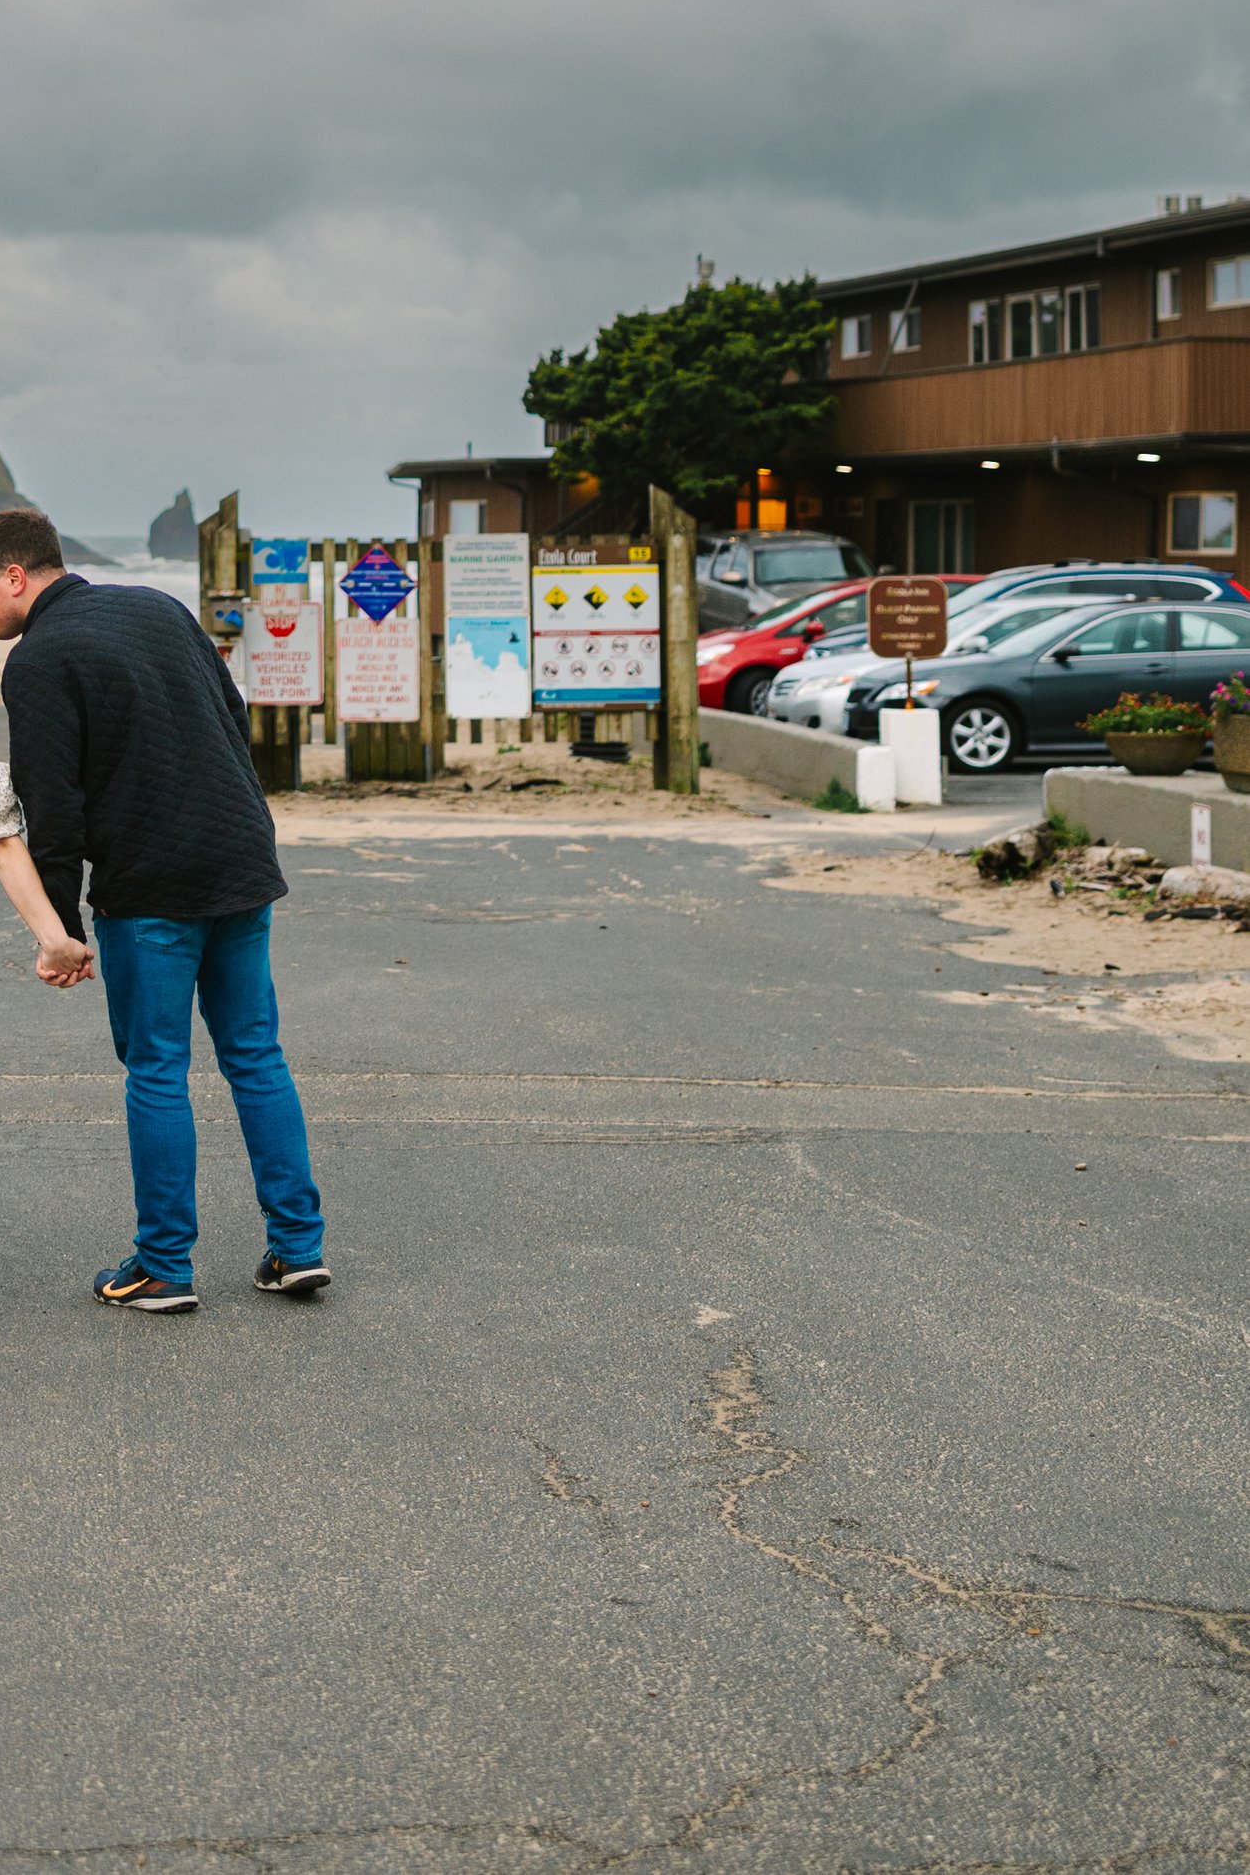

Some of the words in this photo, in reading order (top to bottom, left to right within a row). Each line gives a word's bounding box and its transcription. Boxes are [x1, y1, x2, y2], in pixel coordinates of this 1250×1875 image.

[567, 548, 597, 565] Court
[274, 640, 289, 649] NO
[251, 652, 312, 662] MOTORIZED
[255, 664, 308, 674] VEHICLES
[260, 677, 303, 686] BEYOND
[252, 688, 275, 697] THIS
[282, 688, 312, 697] POINT
